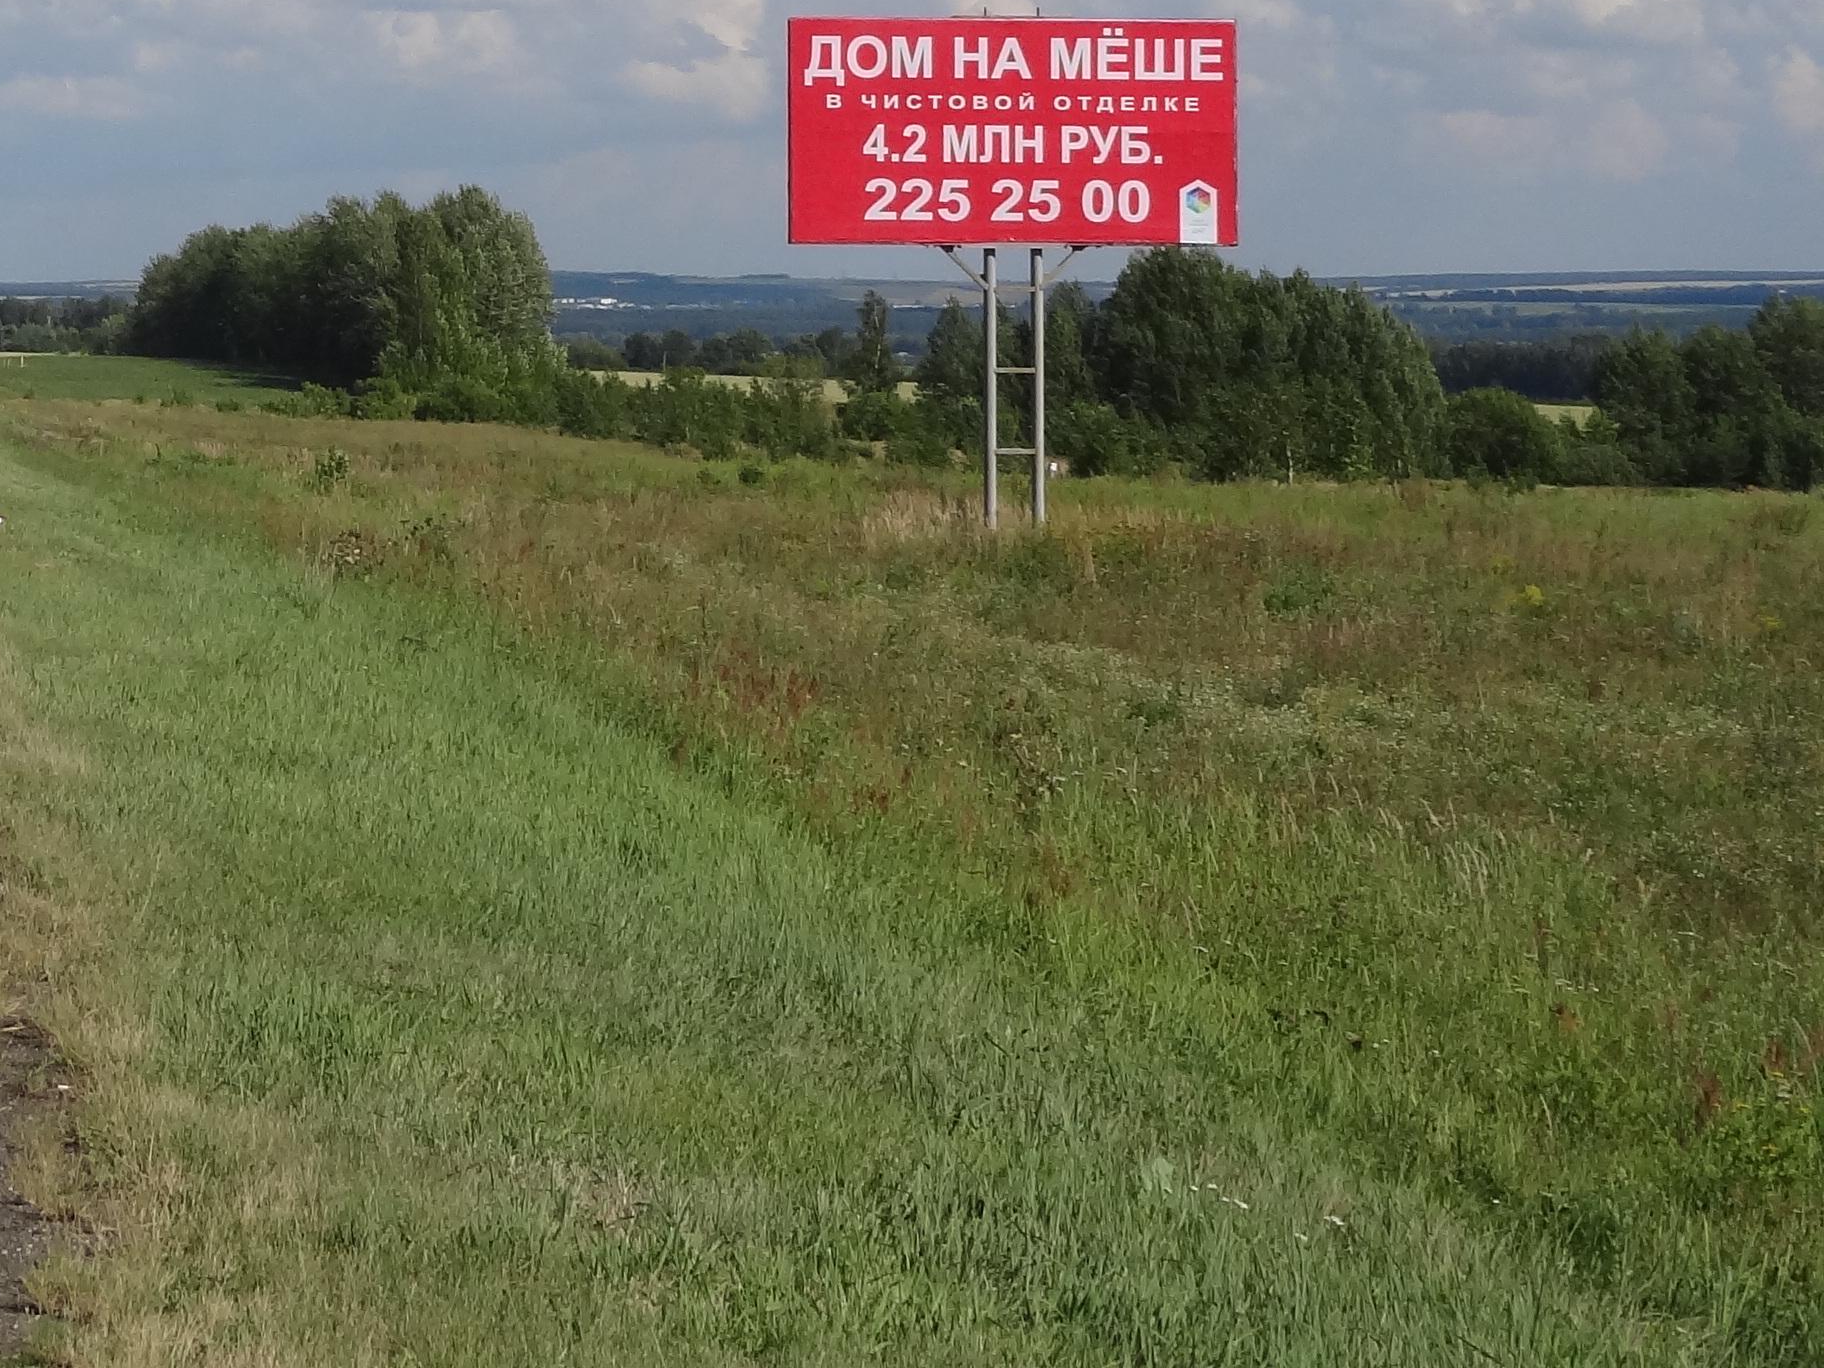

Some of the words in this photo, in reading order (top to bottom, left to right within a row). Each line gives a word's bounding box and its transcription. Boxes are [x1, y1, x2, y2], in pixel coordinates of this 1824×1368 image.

[804, 35, 932, 86] ДОМ
[954, 36, 1032, 79] НА
[1051, 28, 1224, 81] МЁШЕ
[826, 94, 842, 109] В
[861, 93, 1035, 111] ЧИСТОВОЙ
[1053, 96, 1200, 113] ОТДЕЛКЕ
[862, 124, 927, 162] 4.2
[942, 124, 1044, 164] МЛН
[1060, 126, 1164, 165] РУБ.
[863, 178, 971, 222] 225
[990, 179, 1062, 223] 25
[1081, 180, 1151, 223] 00
